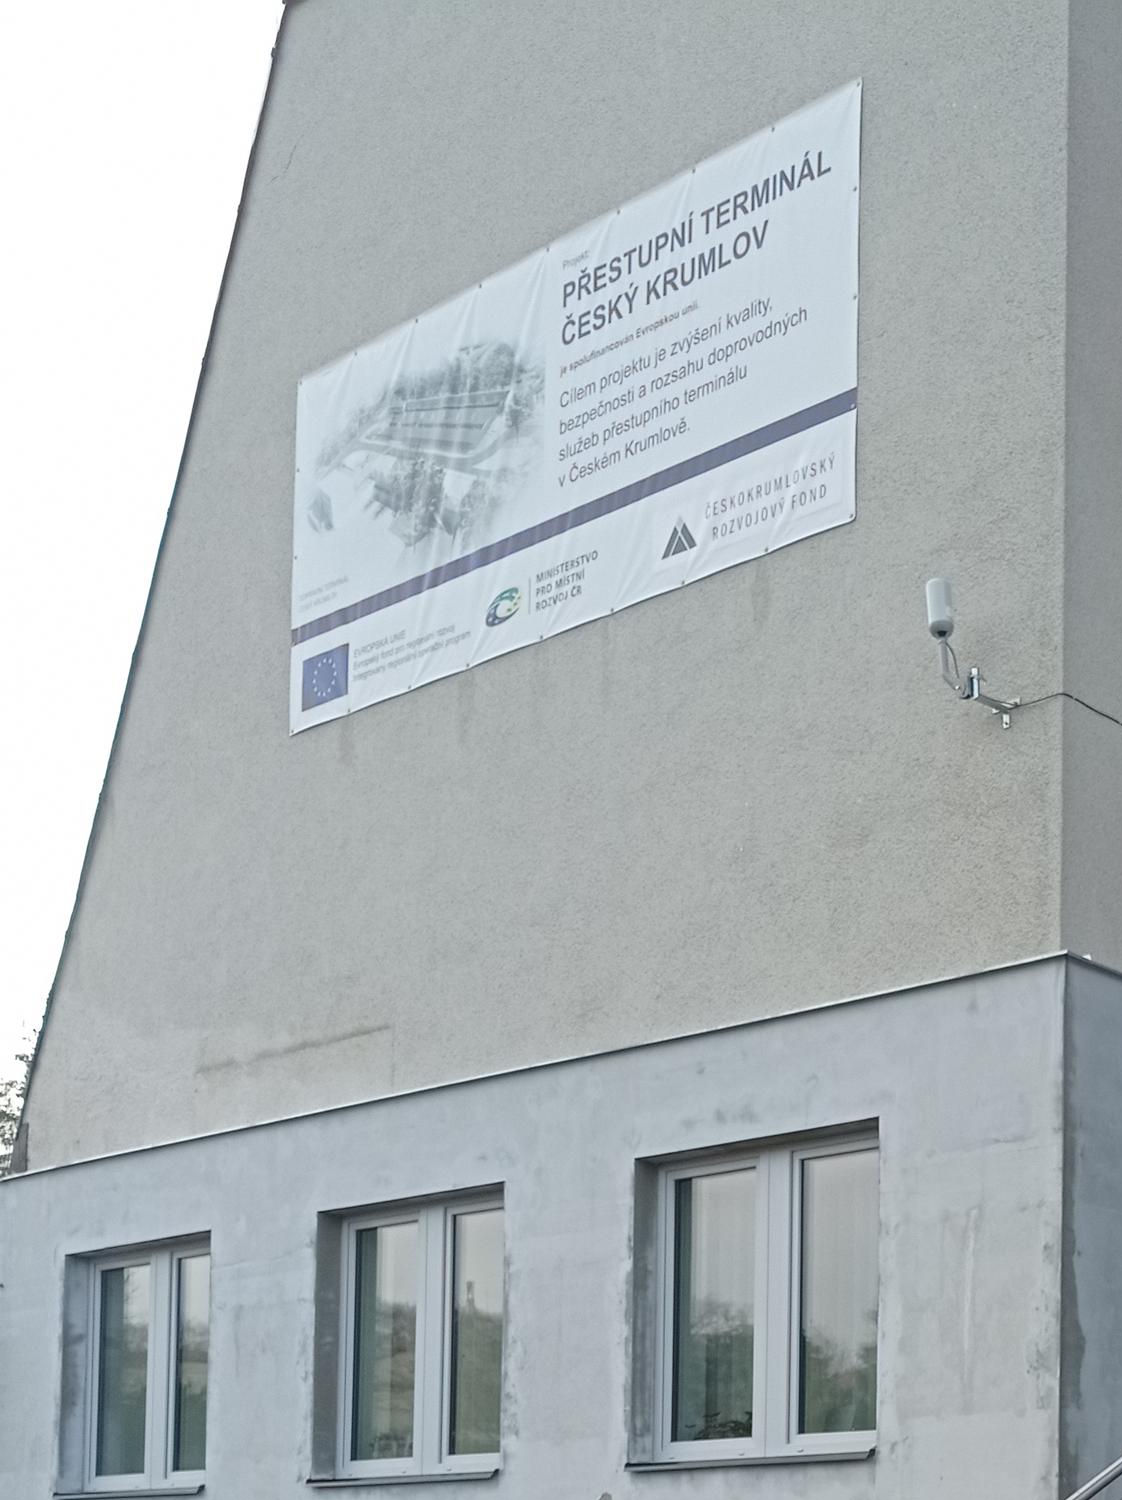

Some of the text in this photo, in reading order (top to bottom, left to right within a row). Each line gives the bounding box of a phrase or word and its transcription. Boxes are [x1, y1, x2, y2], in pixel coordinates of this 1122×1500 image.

[562, 150, 832, 307] PŘESTUPNÍ TERMINÁL
[561, 219, 768, 345] ČESKÝ KRUMLOV
[559, 306, 808, 435] bezpečnosti a rozsahu doprovodných
[600, 353, 651, 393] projektu
[653, 347, 667, 369] je
[670, 317, 722, 357] zvýšení
[726, 297, 773, 331] kvality,
[559, 364, 748, 462] služeb přestupního terminálu
[558, 416, 690, 487] v Českém Krumlově.
[705, 451, 836, 520] ČESKOKRUMLOVSKÝ
[712, 484, 828, 541] ROZVOJOVÝ FOND
[536, 550, 598, 584] MINISTERSTVO
[536, 583, 553, 598] PRO
[536, 590, 569, 612] ROZVOJ
